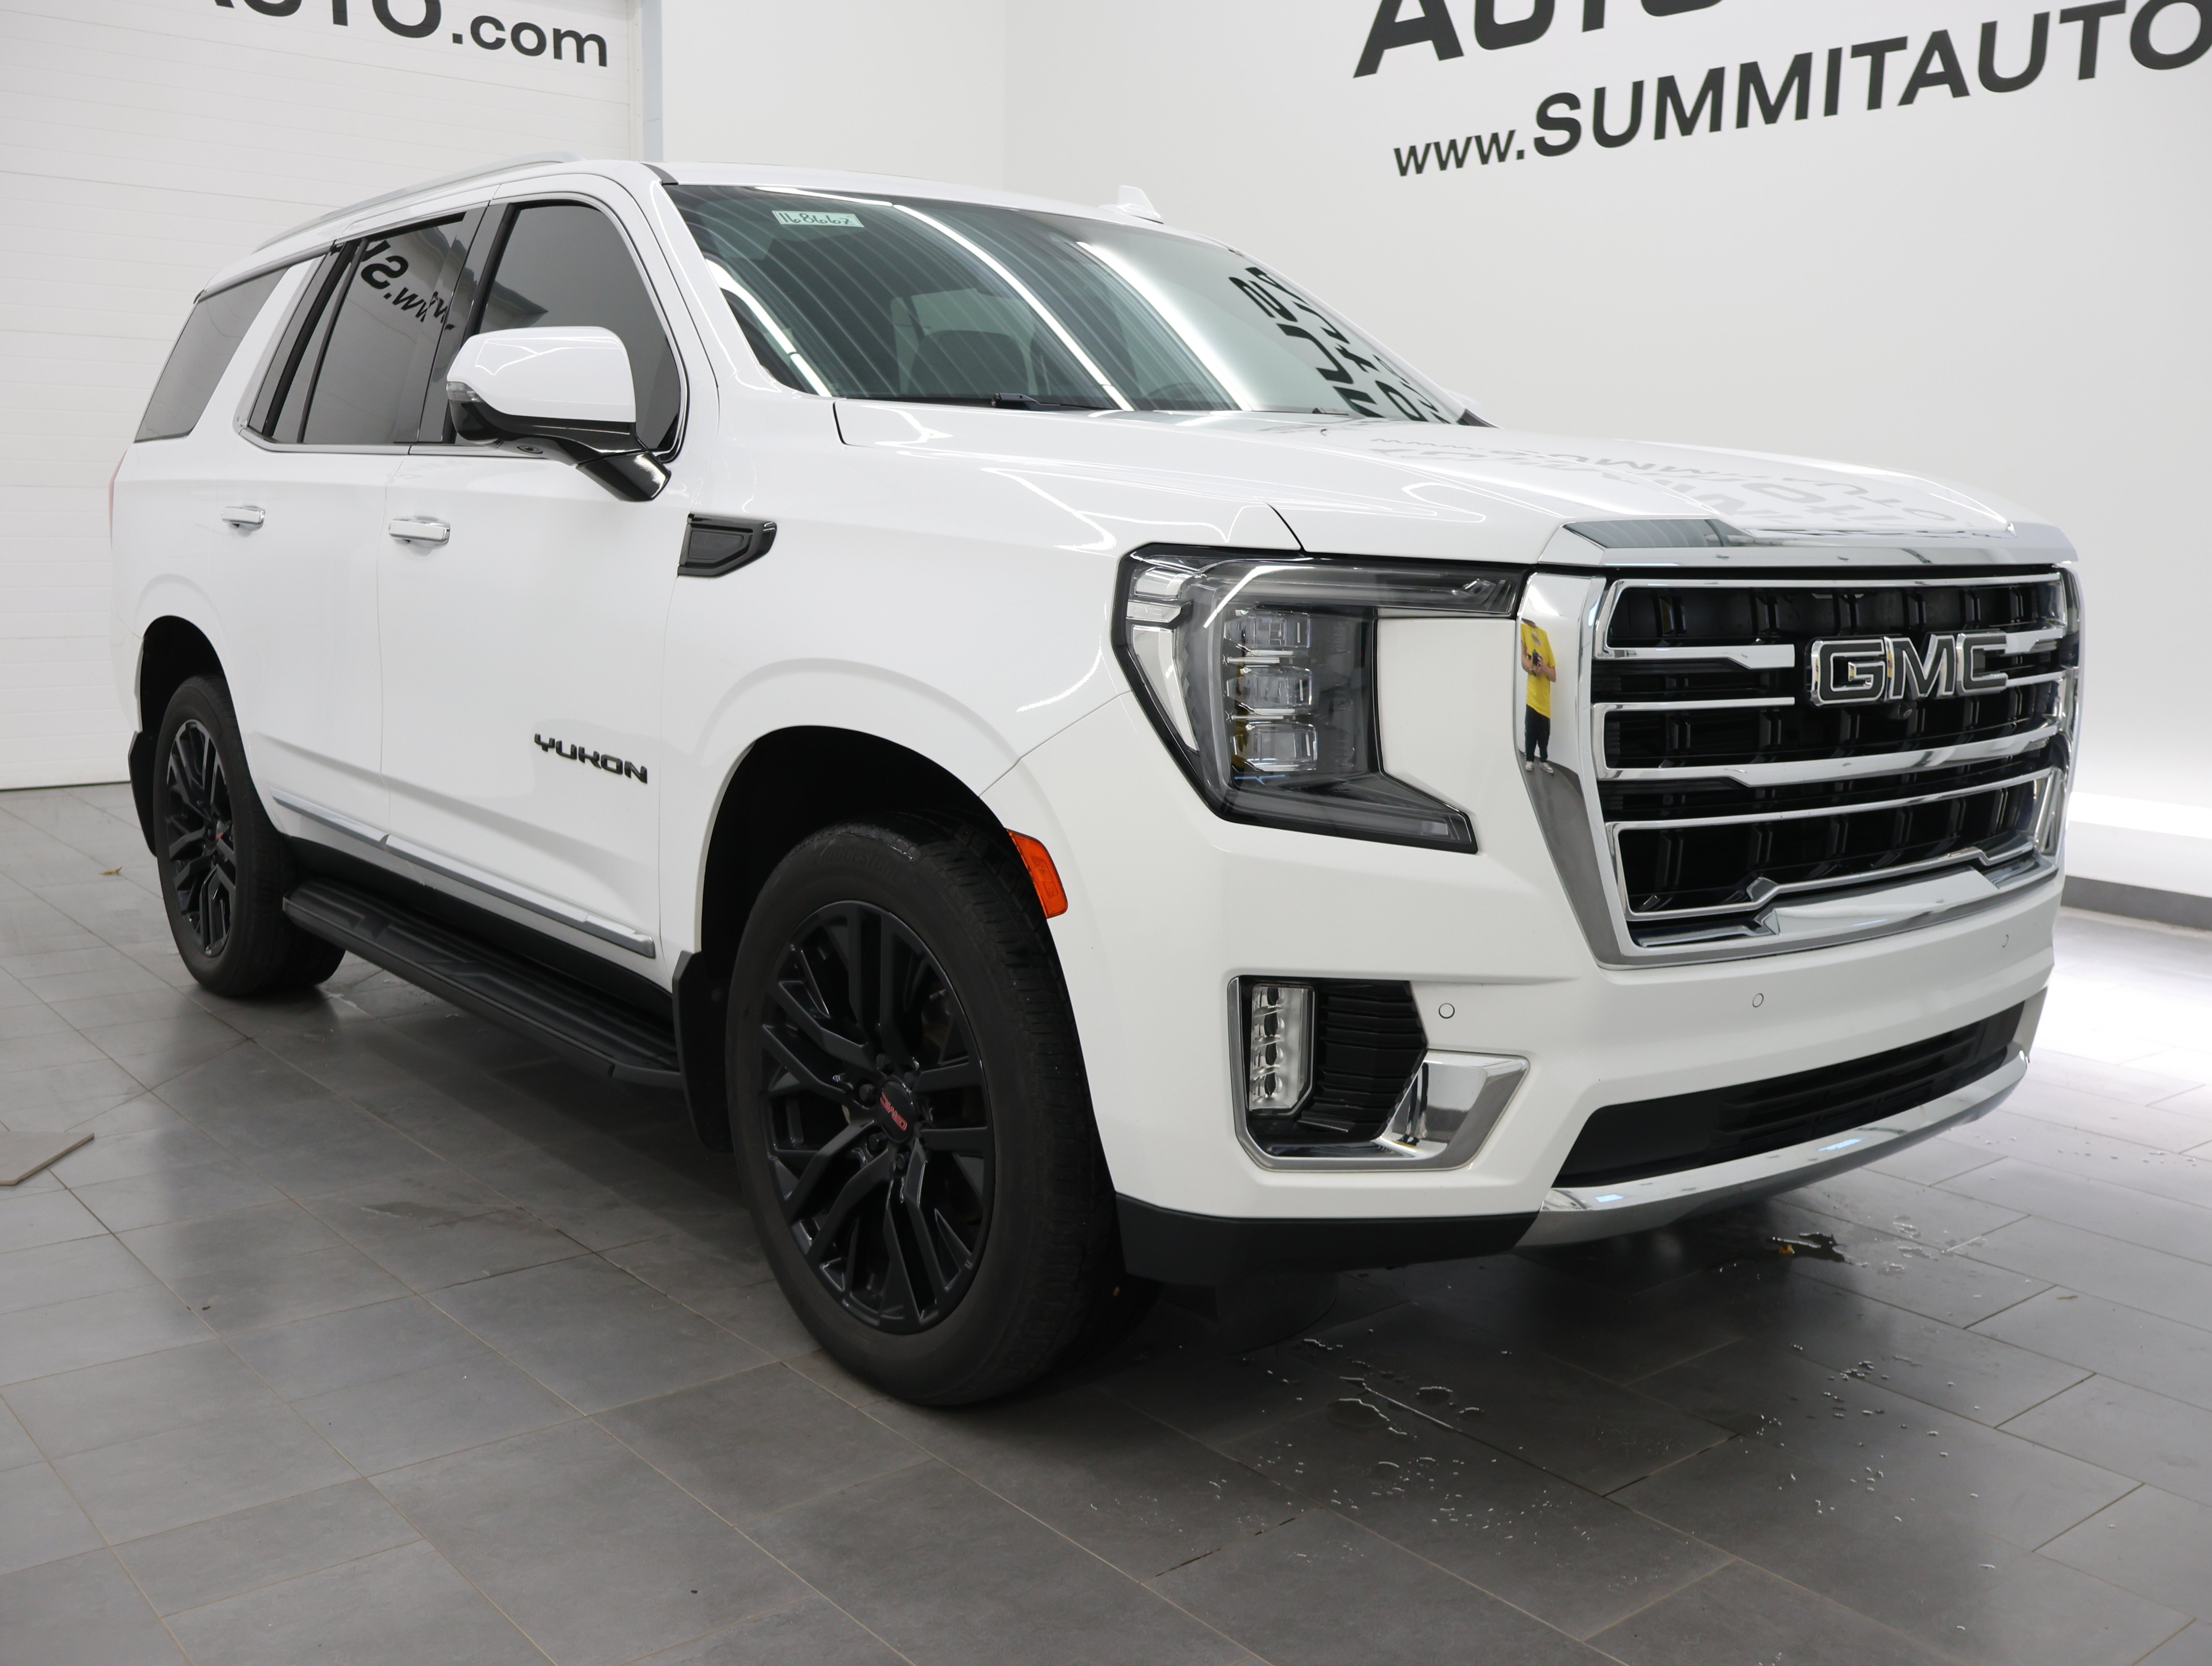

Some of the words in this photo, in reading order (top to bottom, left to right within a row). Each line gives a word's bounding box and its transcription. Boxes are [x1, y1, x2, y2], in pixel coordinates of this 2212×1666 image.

[1811, 632, 2008, 707] GMC
[534, 733, 648, 784] YUKON
[880, 1092, 908, 1131] GMC
